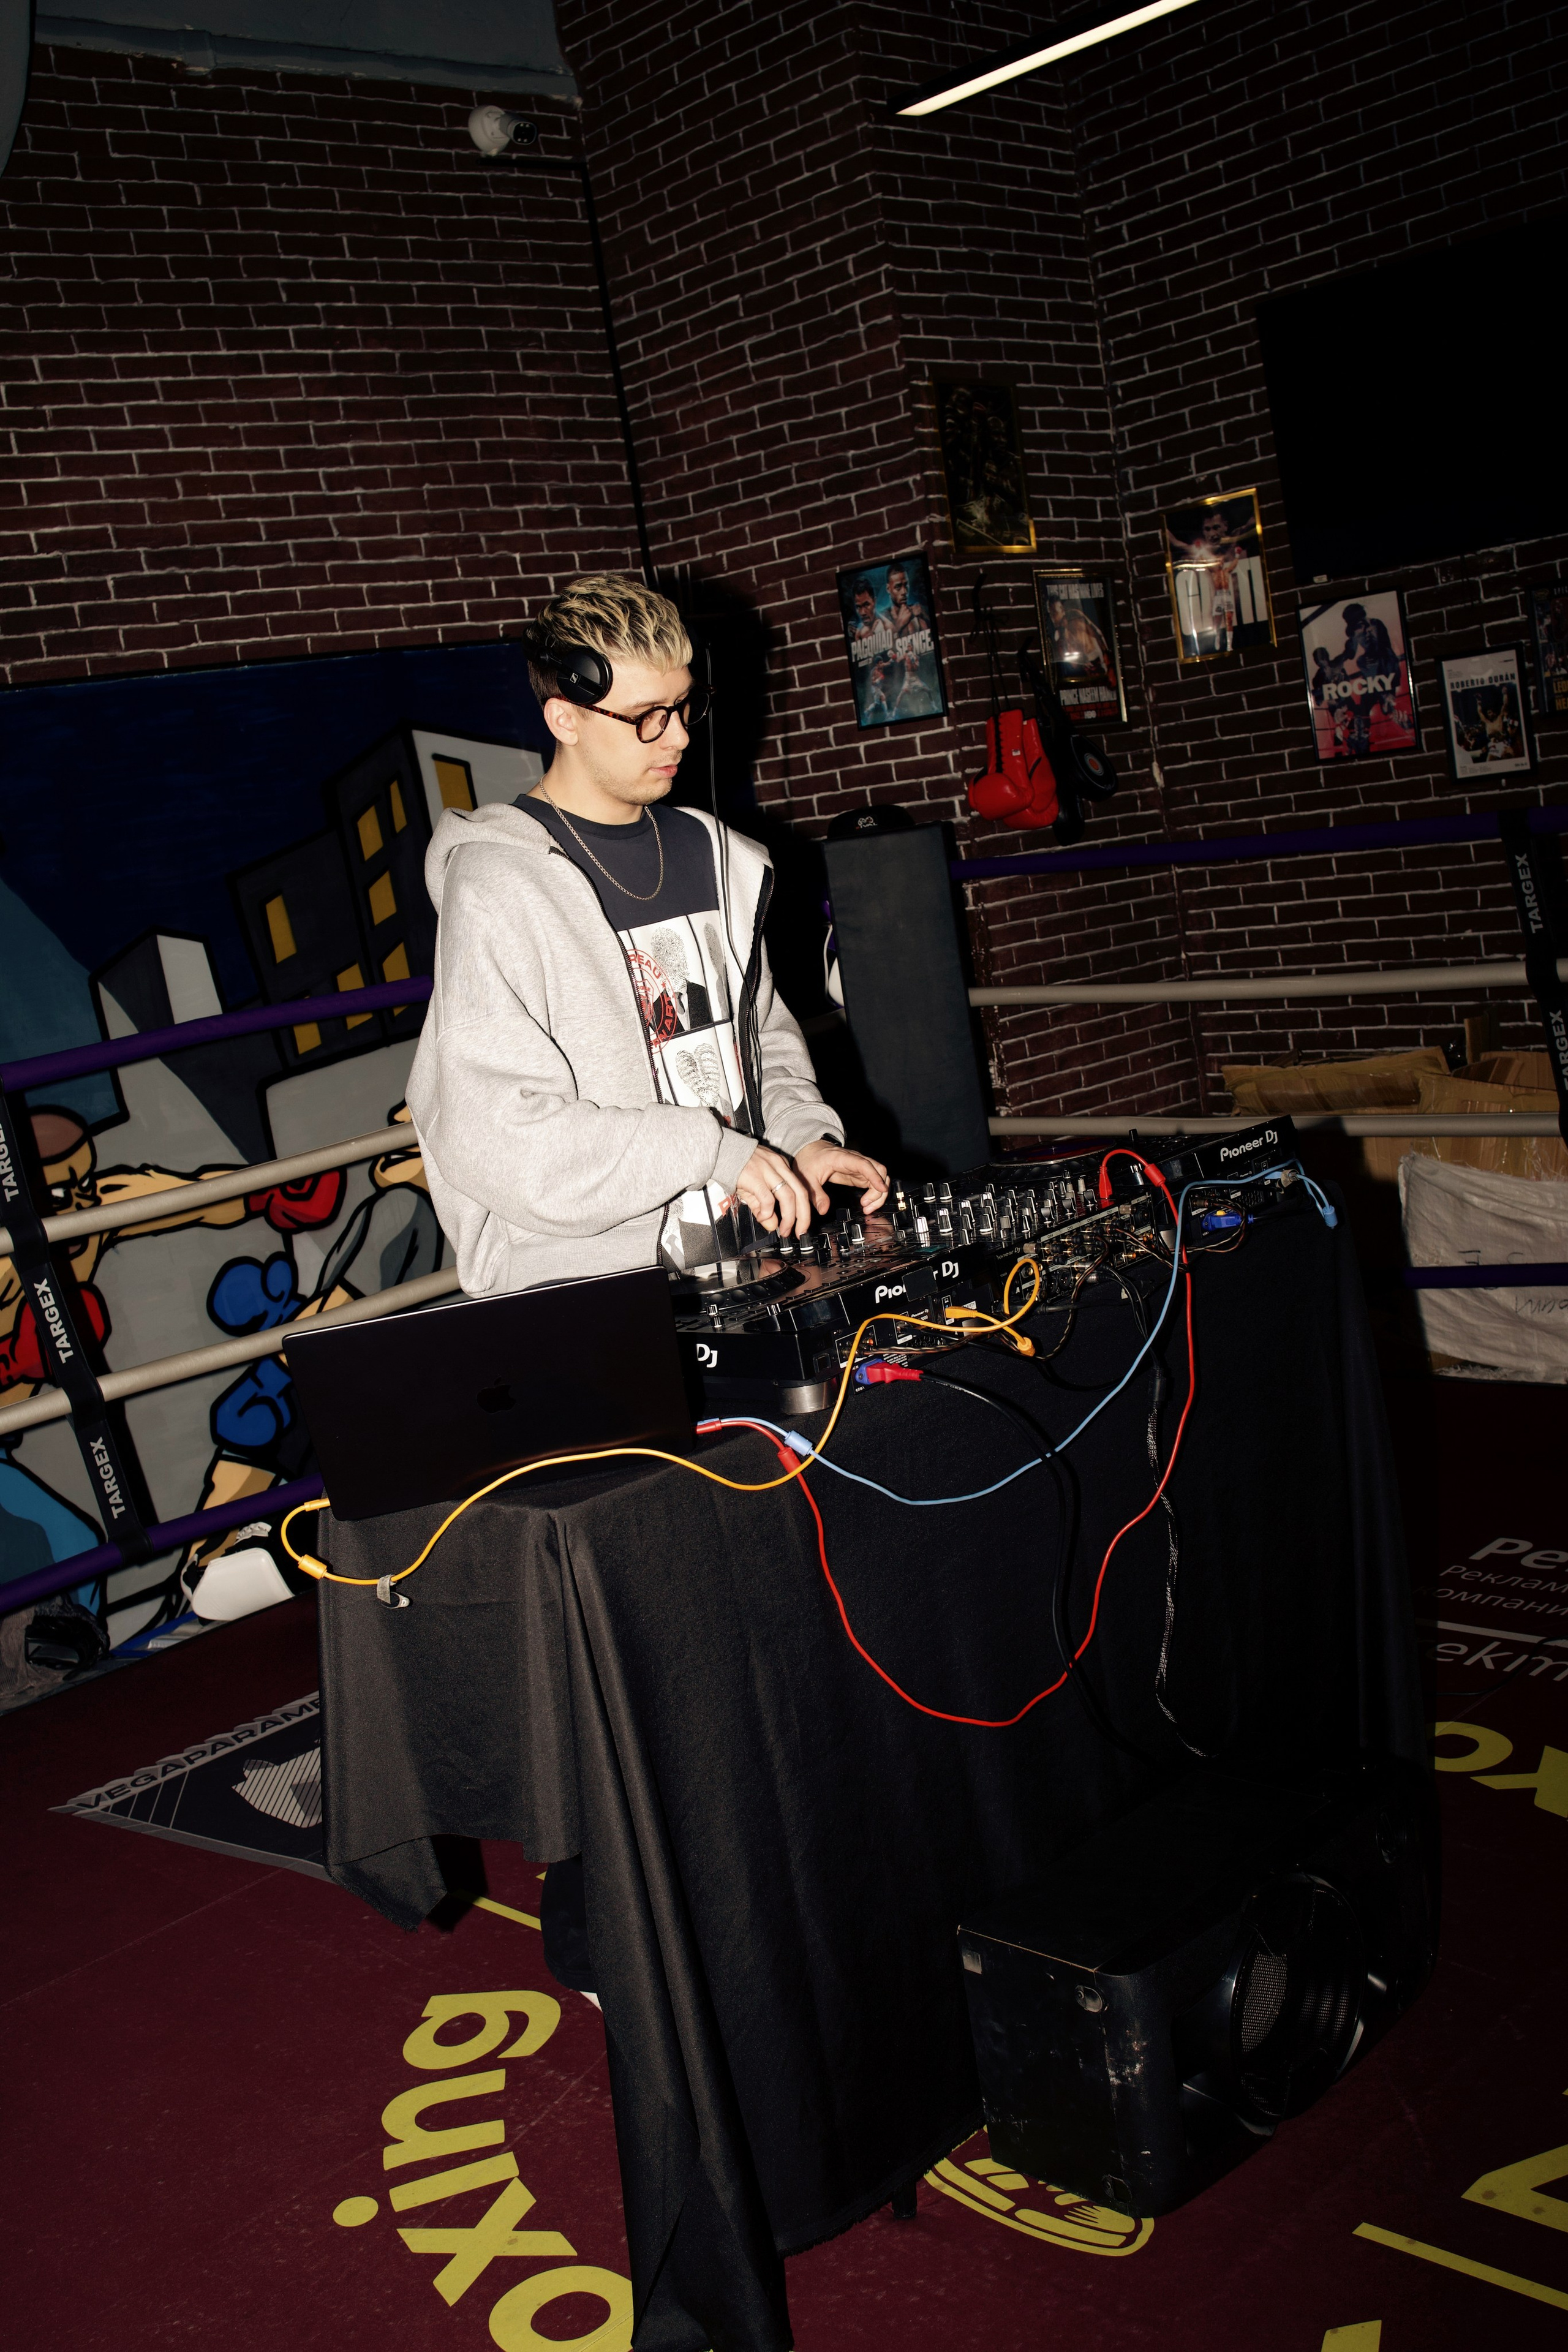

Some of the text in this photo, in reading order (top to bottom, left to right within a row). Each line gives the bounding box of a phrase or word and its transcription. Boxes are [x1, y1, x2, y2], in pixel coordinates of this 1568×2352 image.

[1322, 673, 1396, 701] ROCKY
[1450, 678, 1486, 689] ROBERTO
[1515, 853, 1544, 934] TARGEX
[628, 954, 662, 979] REAU
[1219, 1137, 1264, 1163] Pioneer
[875, 1270, 938, 1304] Pior
[34, 1278, 75, 1364] TARGEX
[89, 1436, 127, 1520] TARGEX
[333, 1989, 635, 2352] oxing
